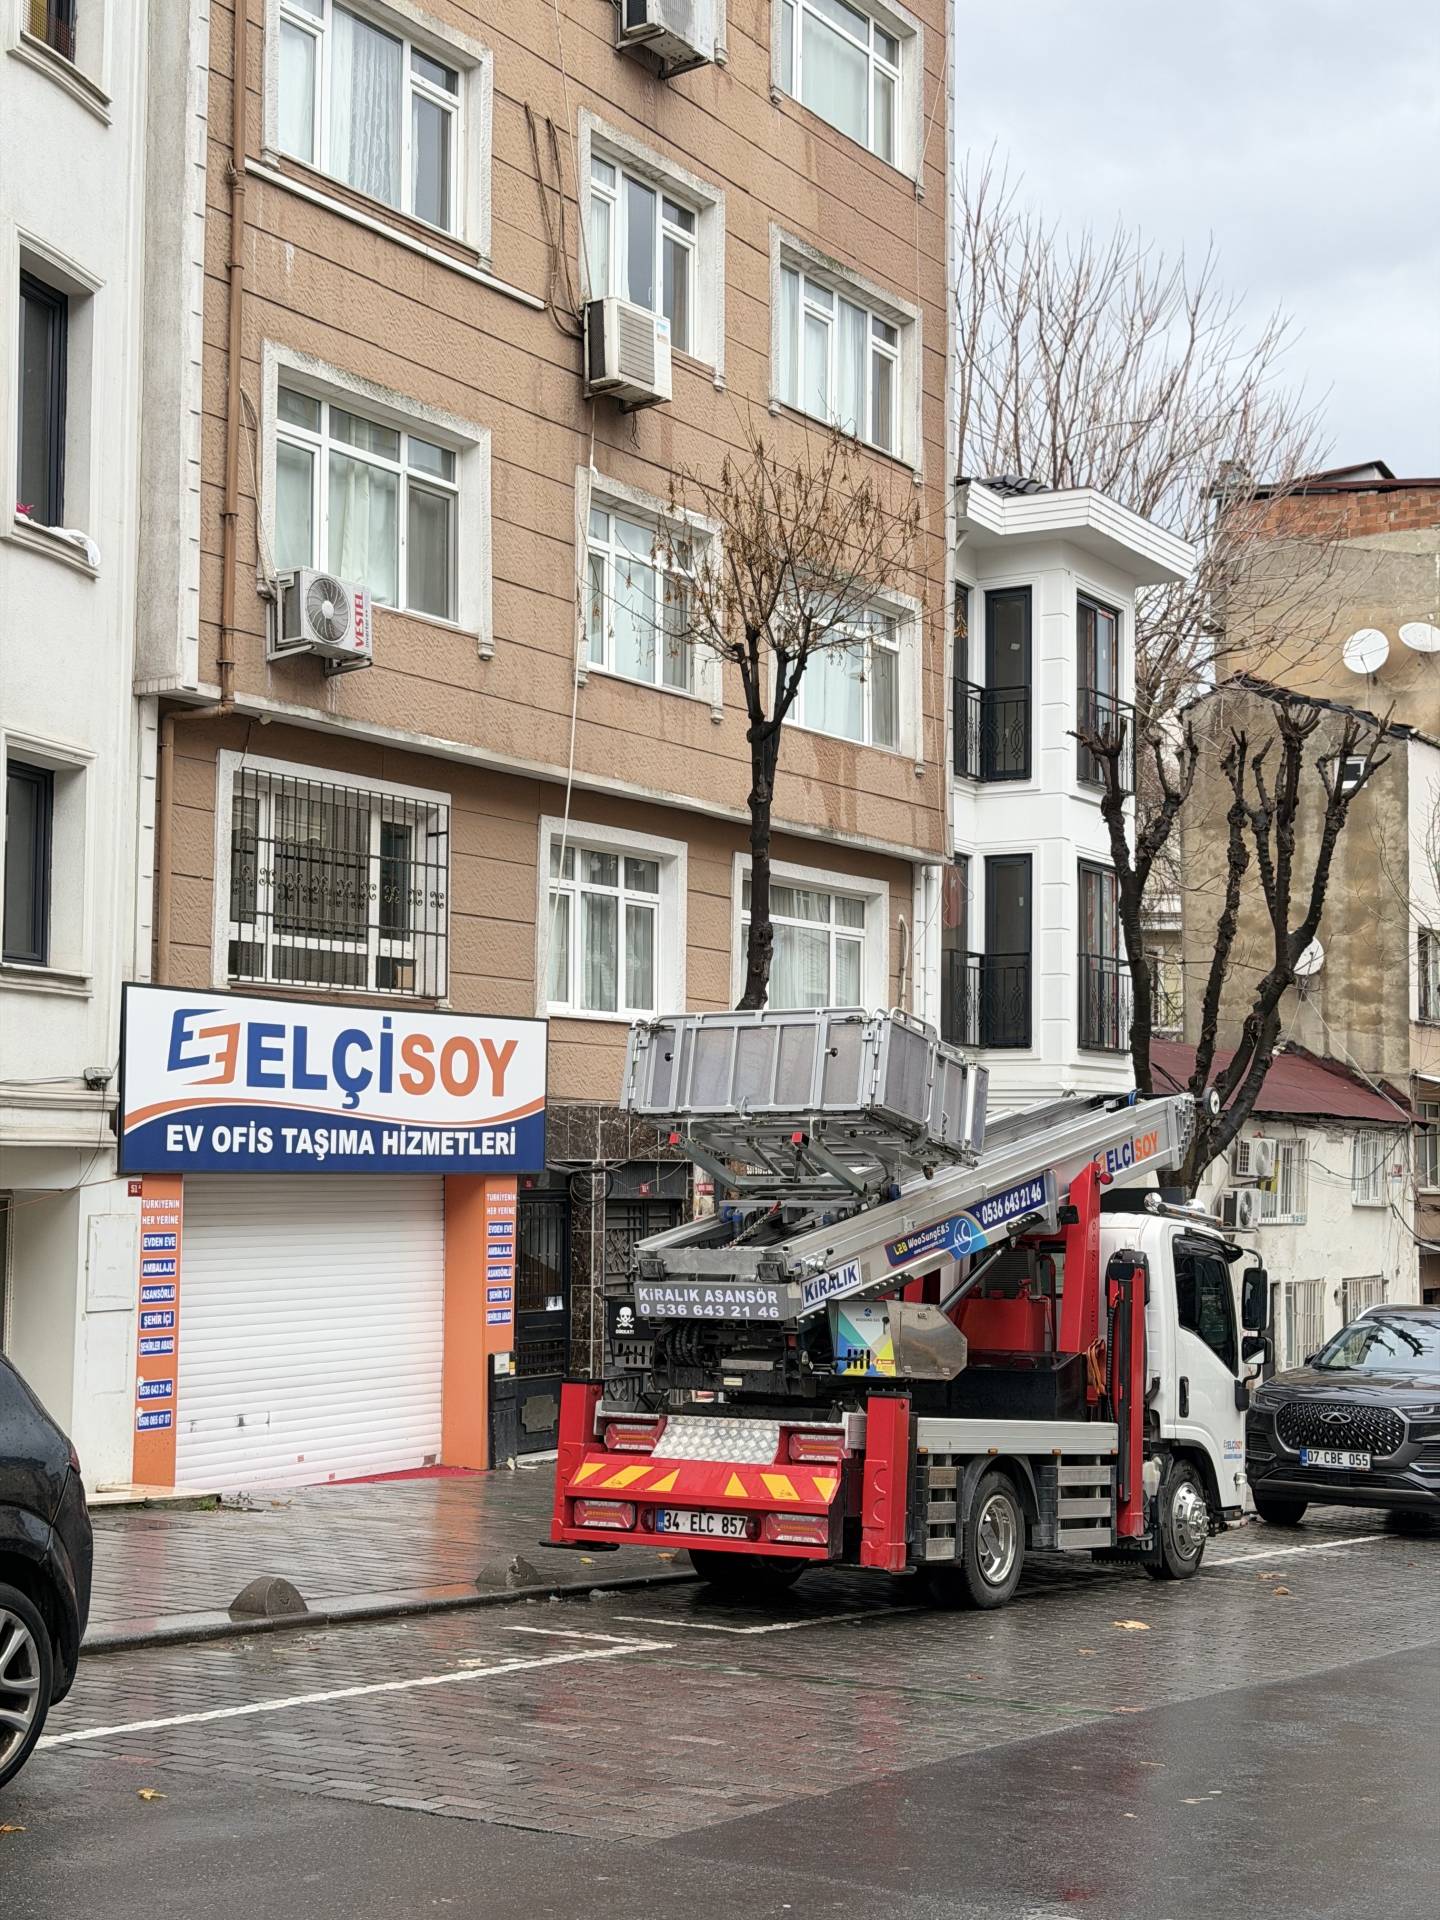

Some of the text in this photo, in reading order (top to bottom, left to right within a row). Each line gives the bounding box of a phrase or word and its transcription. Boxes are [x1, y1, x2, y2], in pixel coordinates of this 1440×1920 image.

[246, 1016, 519, 1109] ELÇİSOY
[166, 1121, 517, 1161] EV OFİS TAŞIMA HİZMETLERİ
[982, 1182, 1042, 1225] 0536 643 21 46
[142, 1213, 179, 1225] HER YERİNE
[143, 1236, 176, 1248] EVDEN EVE
[704, 1287, 778, 1304] ASANSÖR
[640, 1303, 779, 1318] 0 536 643 21 46
[143, 1312, 162, 1328] ŞEHİR
[1307, 1450, 1369, 1466] 07 CBE 055
[663, 1511, 746, 1536] 34 ELC 857
